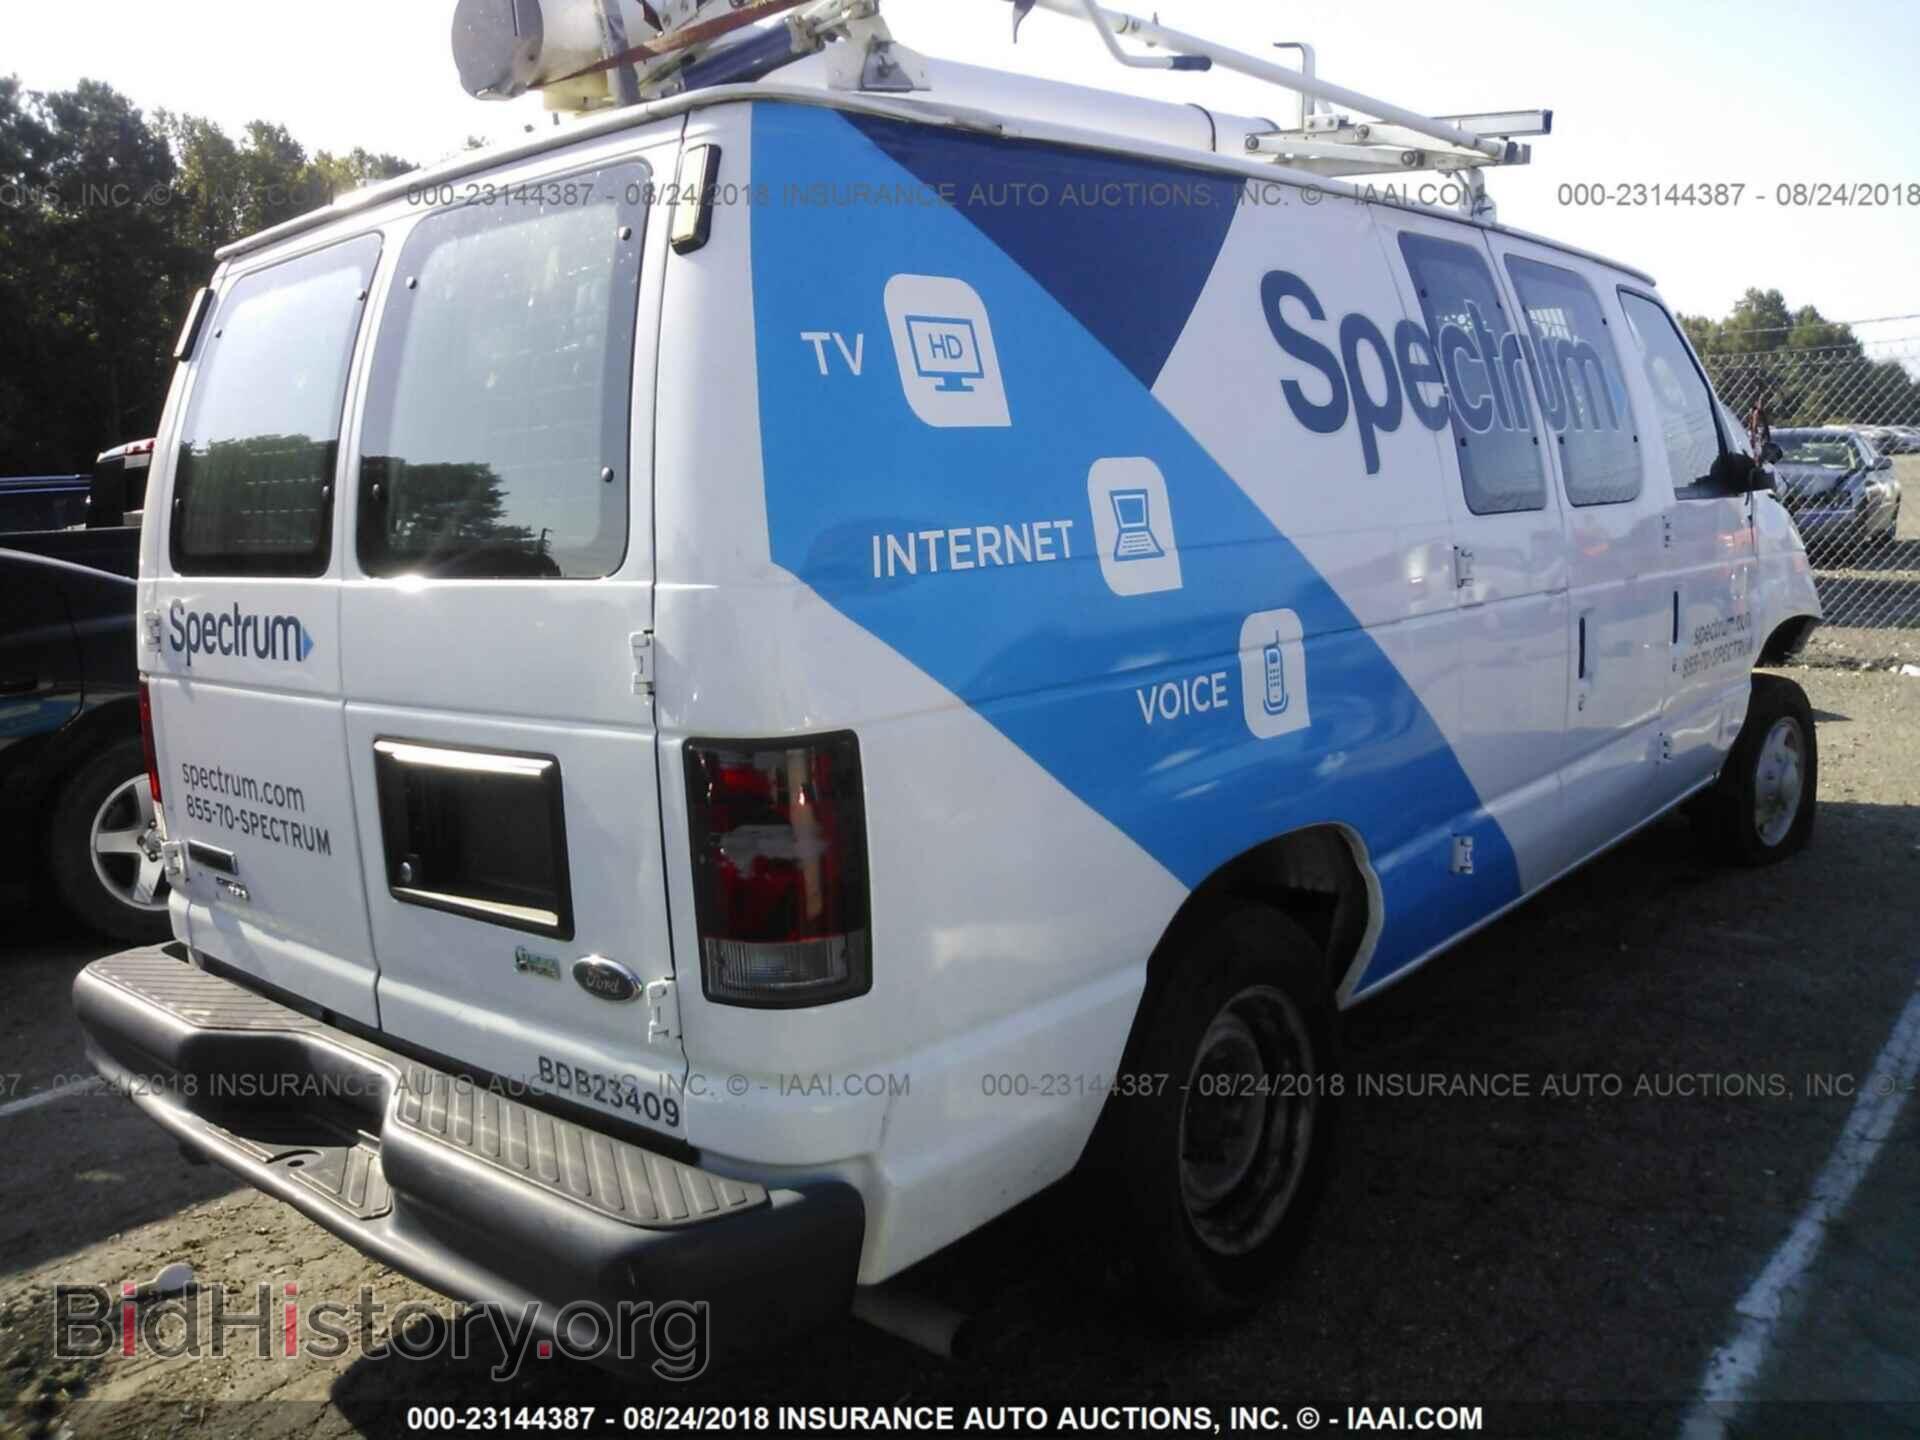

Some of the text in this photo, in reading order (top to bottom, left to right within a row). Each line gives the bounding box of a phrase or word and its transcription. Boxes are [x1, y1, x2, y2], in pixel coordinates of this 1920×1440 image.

[800, 332, 864, 376] TV
[928, 333, 963, 360] HD
[1260, 269, 1621, 475] Spectrum
[872, 519, 1073, 578] INTERNET
[169, 598, 304, 666] Spectrum
[1136, 671, 1229, 725] VOICE
[182, 763, 305, 813] spectrum.com
[186, 795, 331, 856] 855-70-SPECTRUM
[538, 1056, 679, 1127] BDB23409
